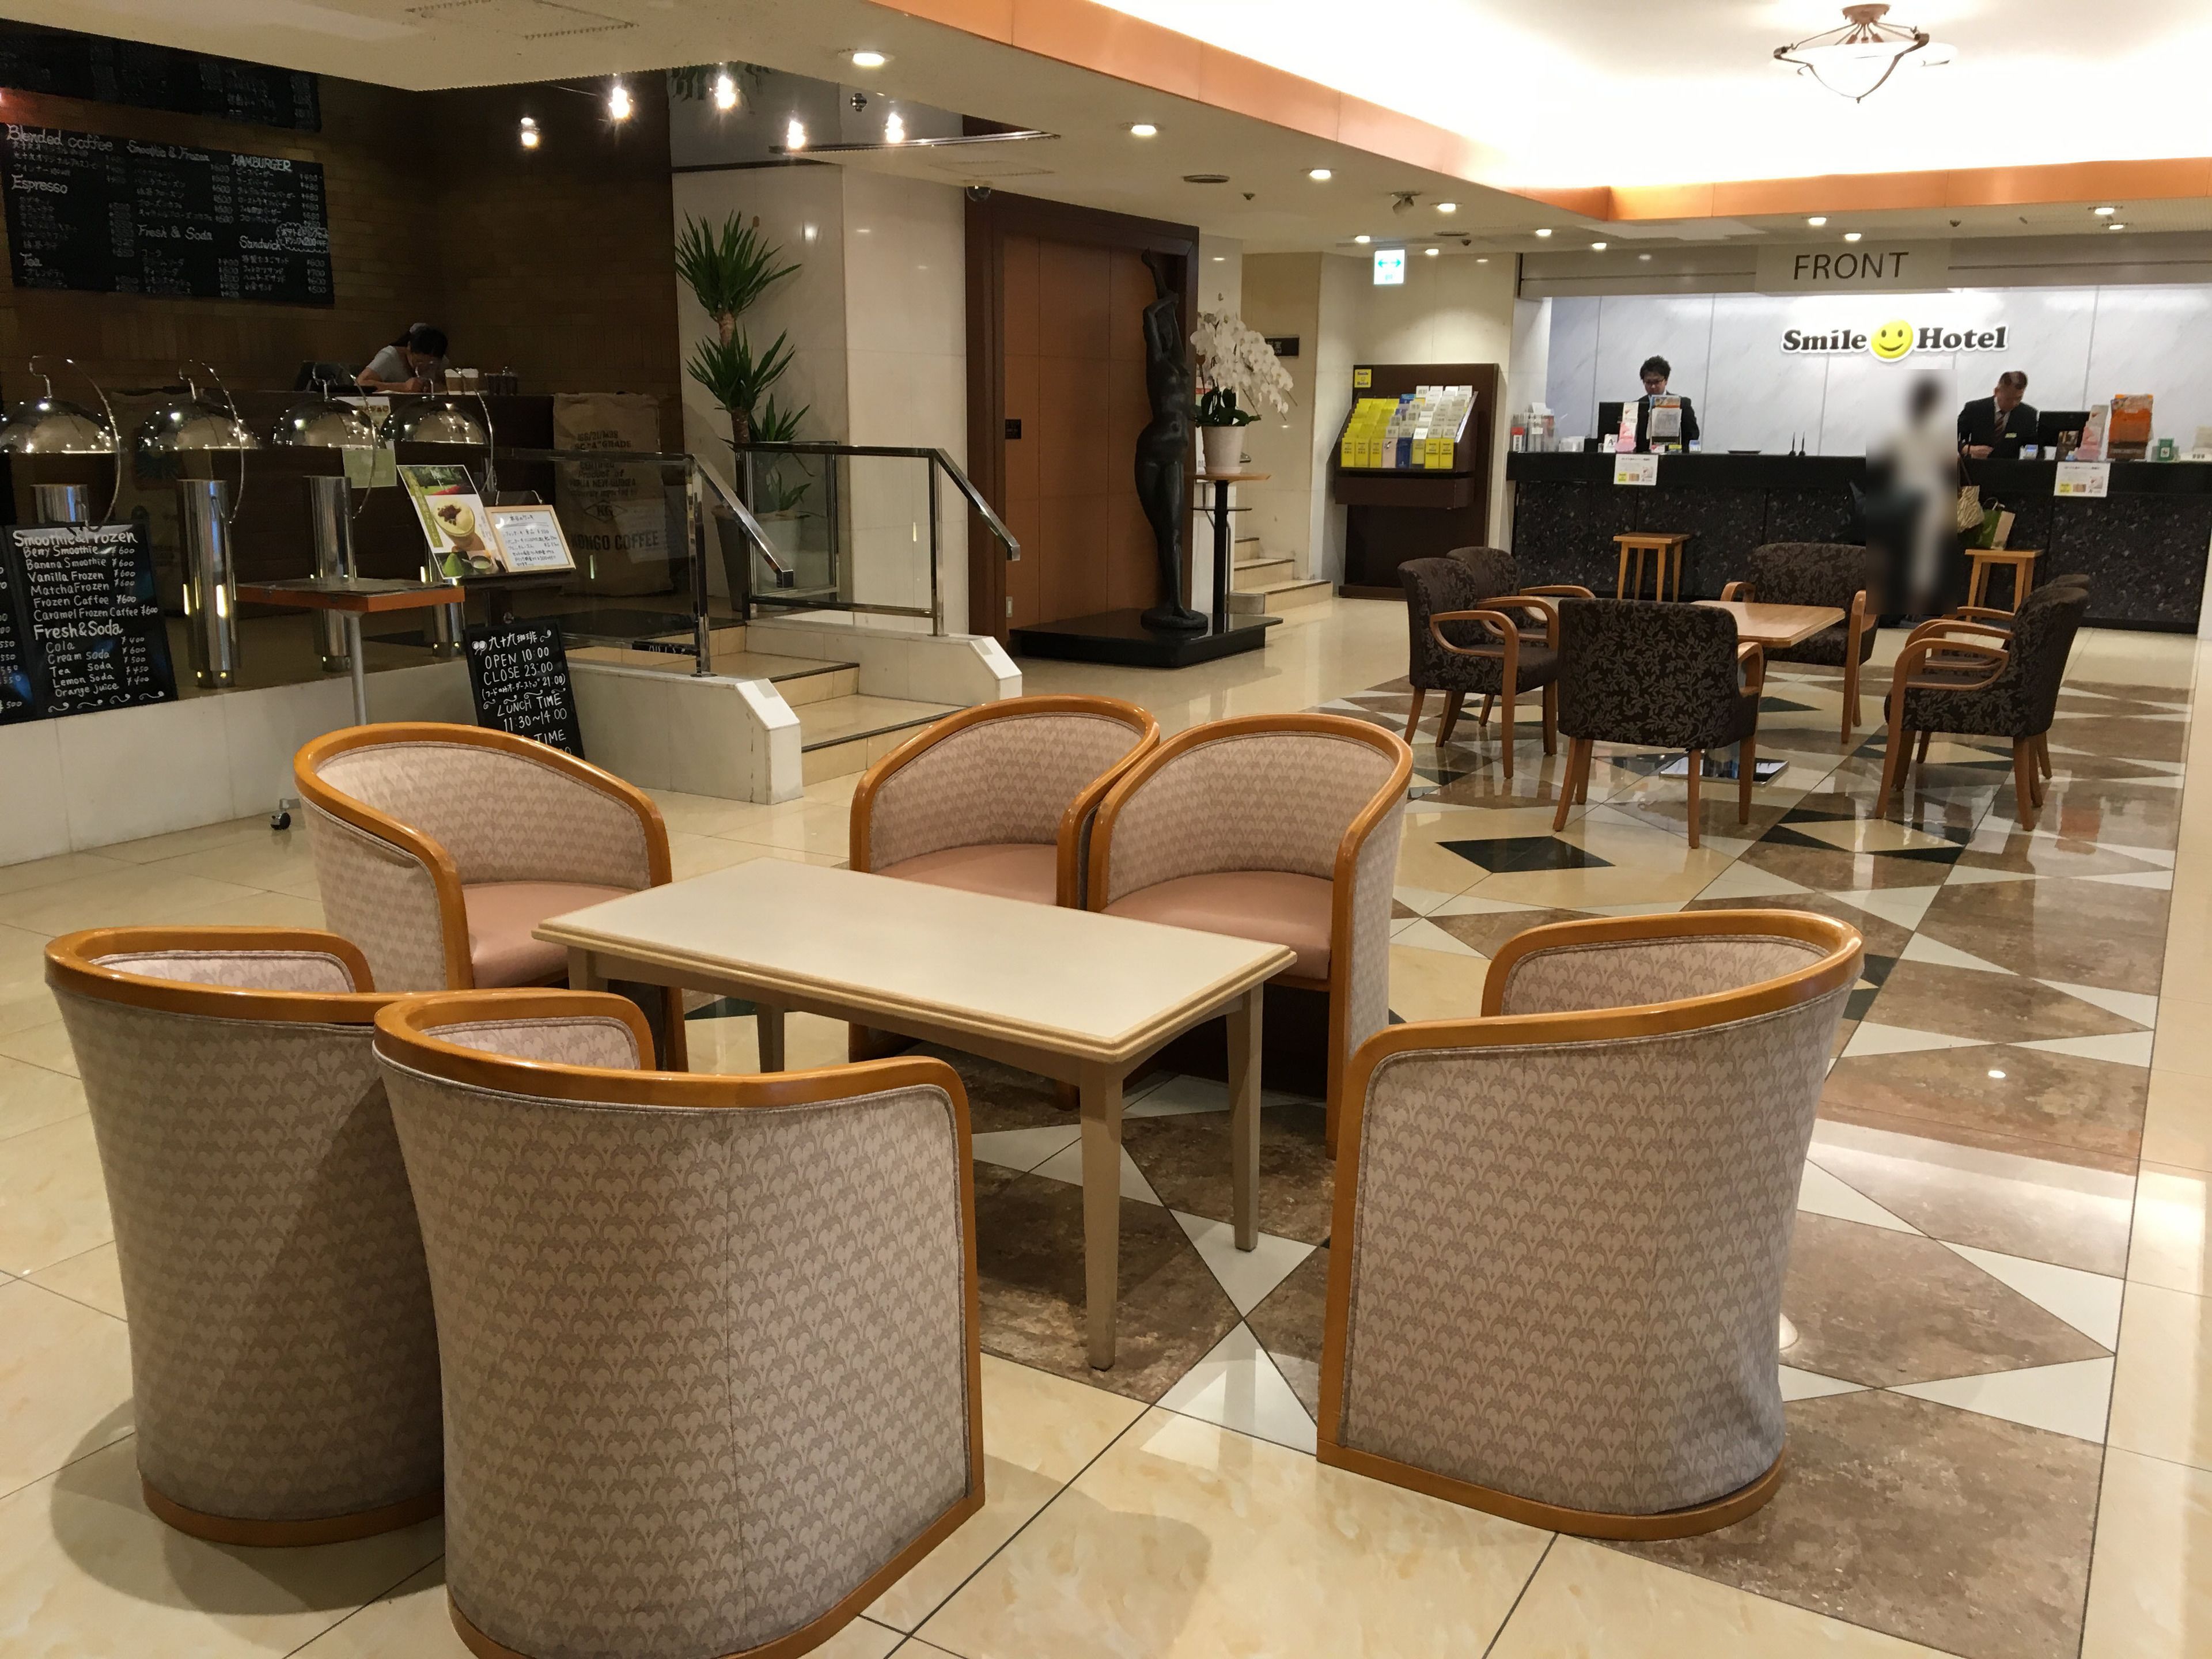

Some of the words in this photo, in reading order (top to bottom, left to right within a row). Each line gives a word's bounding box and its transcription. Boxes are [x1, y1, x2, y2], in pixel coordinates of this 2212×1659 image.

[6, 123, 63, 145] Blended
[231, 154, 293, 172] HAMBURGER
[12, 174, 68, 194] Espresso
[184, 226, 213, 241] Soda
[20, 252, 43, 267] Tea
[1794, 251, 1909, 280] FRONT
[1783, 329, 1867, 350] Smile
[1916, 326, 2006, 349] Hotel
[615, 531, 658, 550] COFFEE
[53, 545, 98, 556] Smoothie
[26, 559, 63, 570] Banana
[64, 557, 107, 567] Smoothie
[28, 572, 69, 582] Vanilla
[71, 571, 105, 581] Frozen
[33, 597, 70, 608] Frozen
[33, 609, 77, 622] Caramel
[79, 608, 108, 618] Frozen
[46, 641, 75, 653] Cola
[48, 653, 82, 664] Cream
[485, 653, 517, 669] OPEN
[521, 647, 549, 662] 10:00
[49, 666, 71, 677] Tea
[484, 666, 520, 685] CLOSE
[524, 661, 553, 677] 23:00
[52, 677, 86, 688] Lemon
[55, 686, 90, 698] Orange
[497, 699, 532, 717] LUNCH
[536, 693, 562, 709] TIME
[533, 729, 566, 745] TIME
